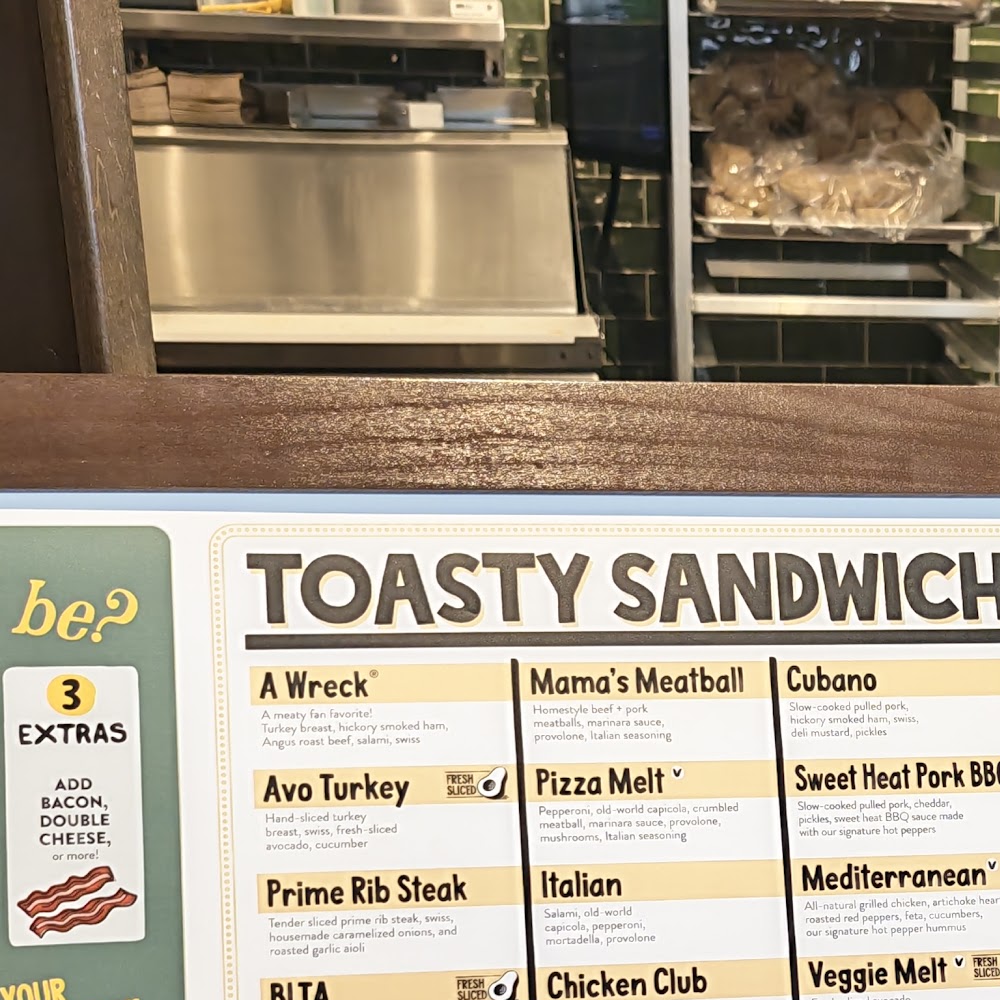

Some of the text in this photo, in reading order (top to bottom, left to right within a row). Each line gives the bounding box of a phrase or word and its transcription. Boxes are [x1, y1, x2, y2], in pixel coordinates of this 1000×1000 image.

[246, 553, 590, 625] TOASTY
[11, 579, 138, 642] be?
[260, 672, 277, 699] A
[531, 667, 743, 695] Mama's Meatball
[787, 666, 876, 692] Cubano
[62, 679, 81, 710] 3
[261, 708, 372, 722] A meaty fan favorite!
[19, 723, 127, 745] EXTRAS
[55, 778, 92, 790] ADD
[446, 774, 473, 784] FRESH
[536, 769, 602, 795] Pizza
[609, 767, 664, 794] Melt
[795, 765, 857, 791] Sweet
[863, 763, 910, 789] Heat
[916, 762, 965, 788] Pork
[263, 773, 409, 808] Avo Turkey
[447, 785, 476, 795] SLICED
[42, 796, 107, 810] BACON,
[41, 814, 109, 827] DOUBLE
[266, 811, 366, 824] Hand-sliced turkey
[40, 832, 111, 847] CHEESE,
[67, 849, 98, 860] more!
[542, 871, 621, 898] Italian
[802, 863, 986, 891] Mediterranean
[267, 874, 467, 907] Prime Rib Steak
[270, 943, 364, 957] roasted garlic aioli
[973, 957, 997, 967] FRESH
[974, 968, 1000, 977] SLICED
[457, 979, 484, 989] FRESH
[548, 967, 707, 999] Chicken Club
[808, 961, 888, 993] Veggie
[895, 958, 947, 984] Melt
[458, 990, 487, 1000] SLICED
